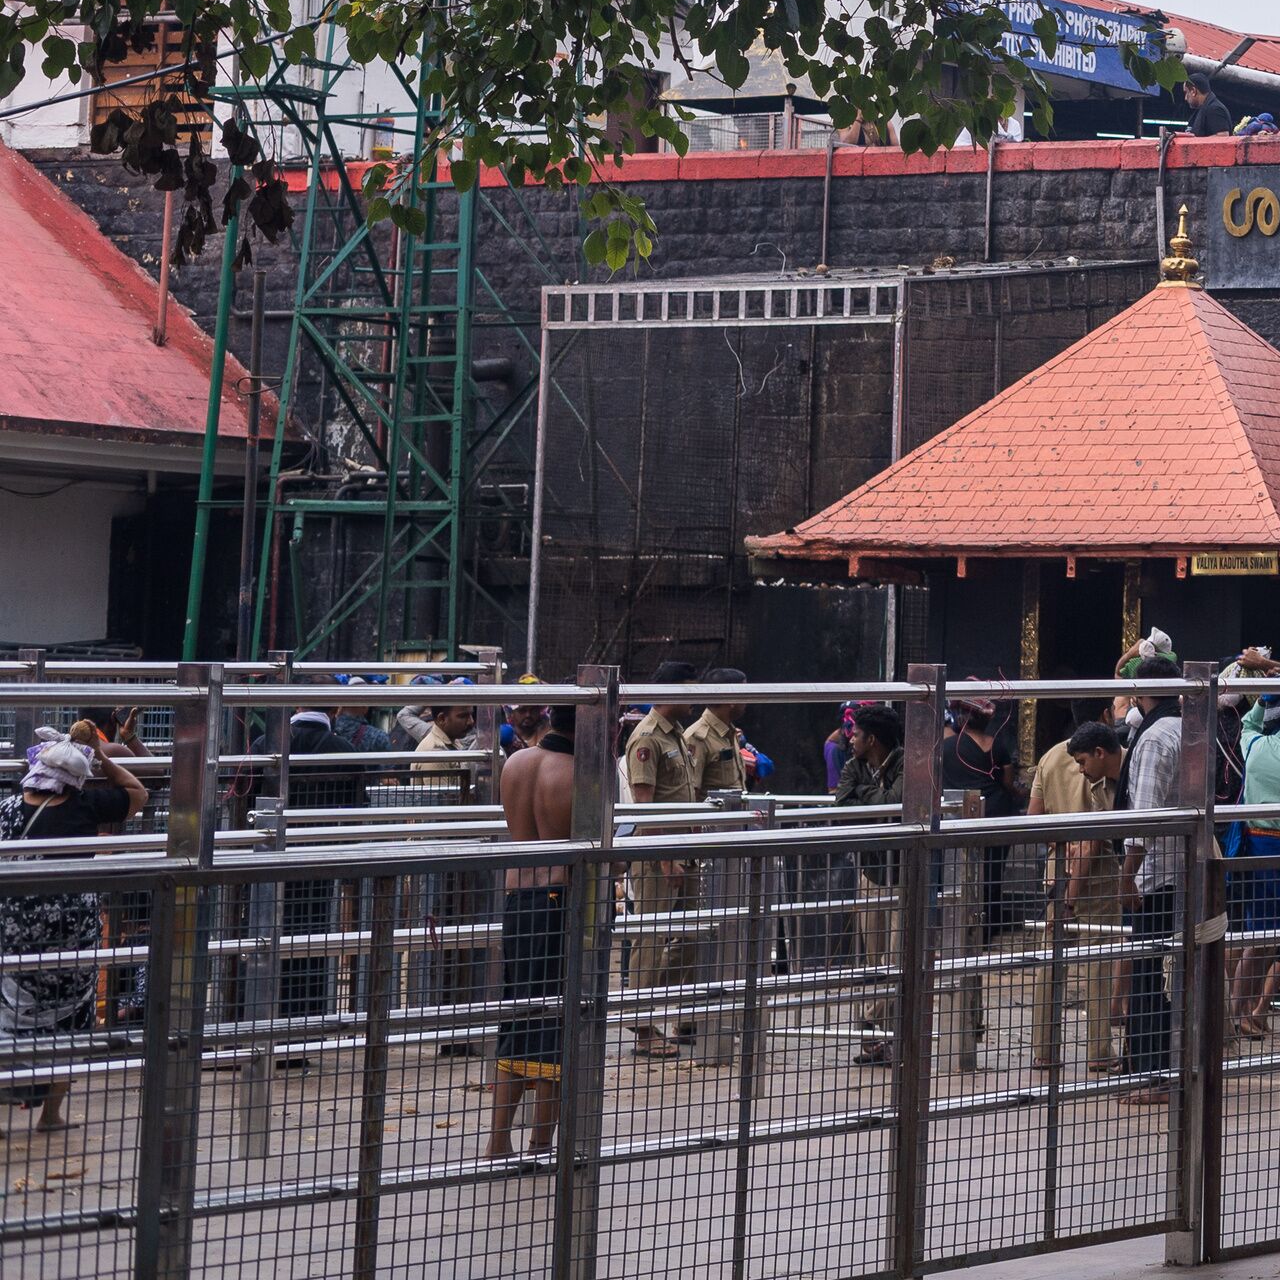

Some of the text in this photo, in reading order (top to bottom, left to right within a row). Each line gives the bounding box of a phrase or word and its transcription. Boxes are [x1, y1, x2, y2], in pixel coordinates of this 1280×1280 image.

[1008, 0, 1050, 26] PHON
[1065, 10, 1147, 50] PHOTOGRAPHY
[1030, 36, 1096, 73] PRHIBITED
[1196, 556, 1273, 569] VALIYA KADUTHA SWAMY
